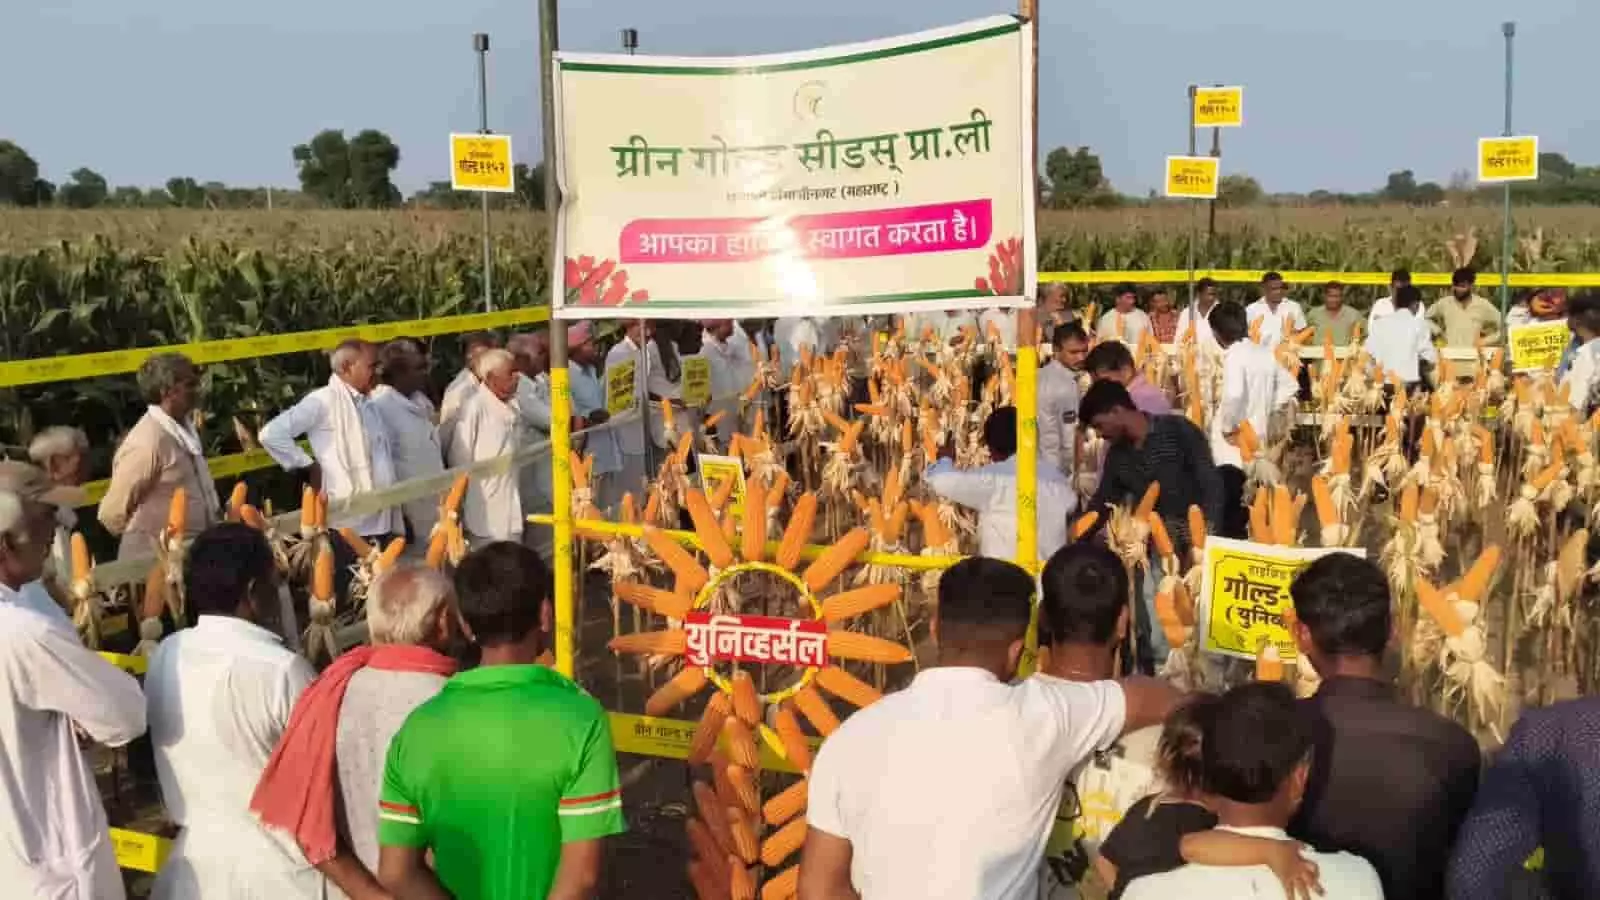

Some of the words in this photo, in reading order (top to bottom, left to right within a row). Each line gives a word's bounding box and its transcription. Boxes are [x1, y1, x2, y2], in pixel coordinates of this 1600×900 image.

[609, 134, 684, 177] ग्रीन
[687, 134, 788, 177] गोड
[793, 128, 903, 173] सीडस्
[639, 232, 718, 256] आपका
[808, 225, 883, 250] स्वागत
[886, 219, 949, 247] करता
[684, 614, 829, 666] युनिव्हर्सल
